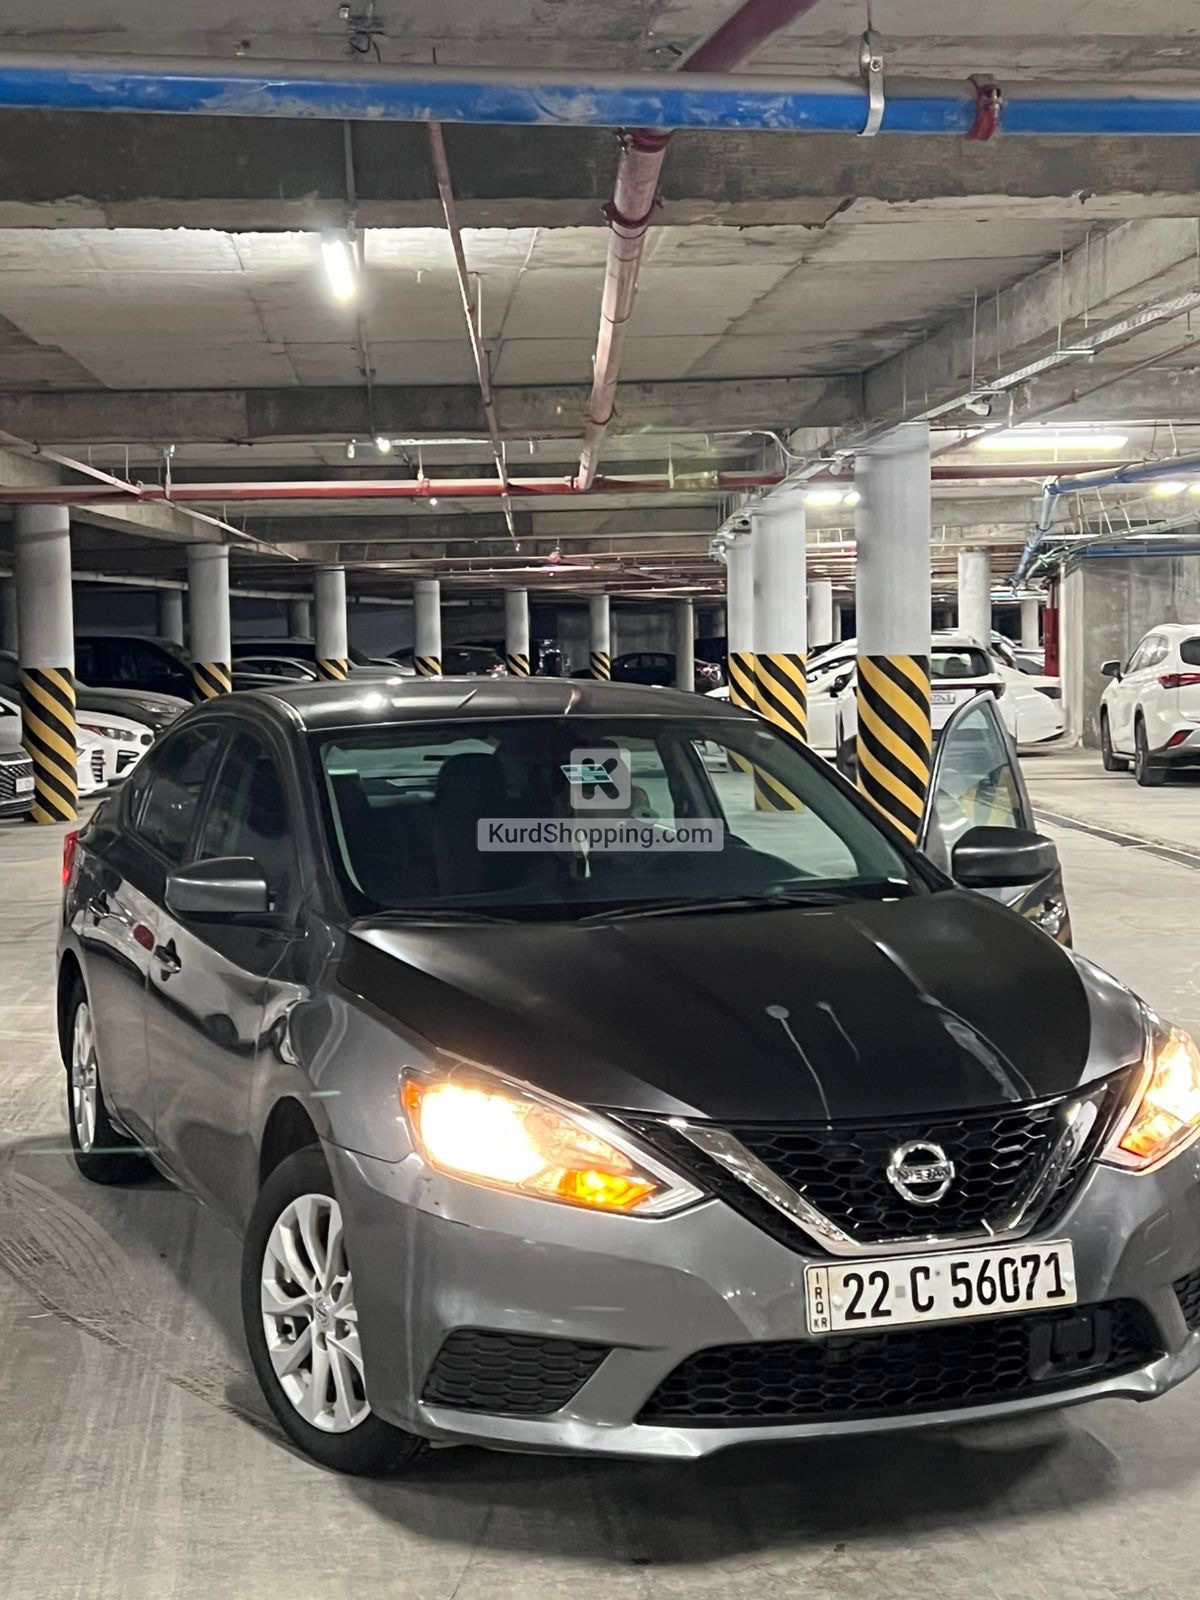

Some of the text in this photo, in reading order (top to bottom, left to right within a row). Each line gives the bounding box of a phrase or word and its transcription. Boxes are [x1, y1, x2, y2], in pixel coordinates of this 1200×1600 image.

[843, 1252, 1066, 1321] 22 C 56071
[814, 1317, 827, 1328] KR
